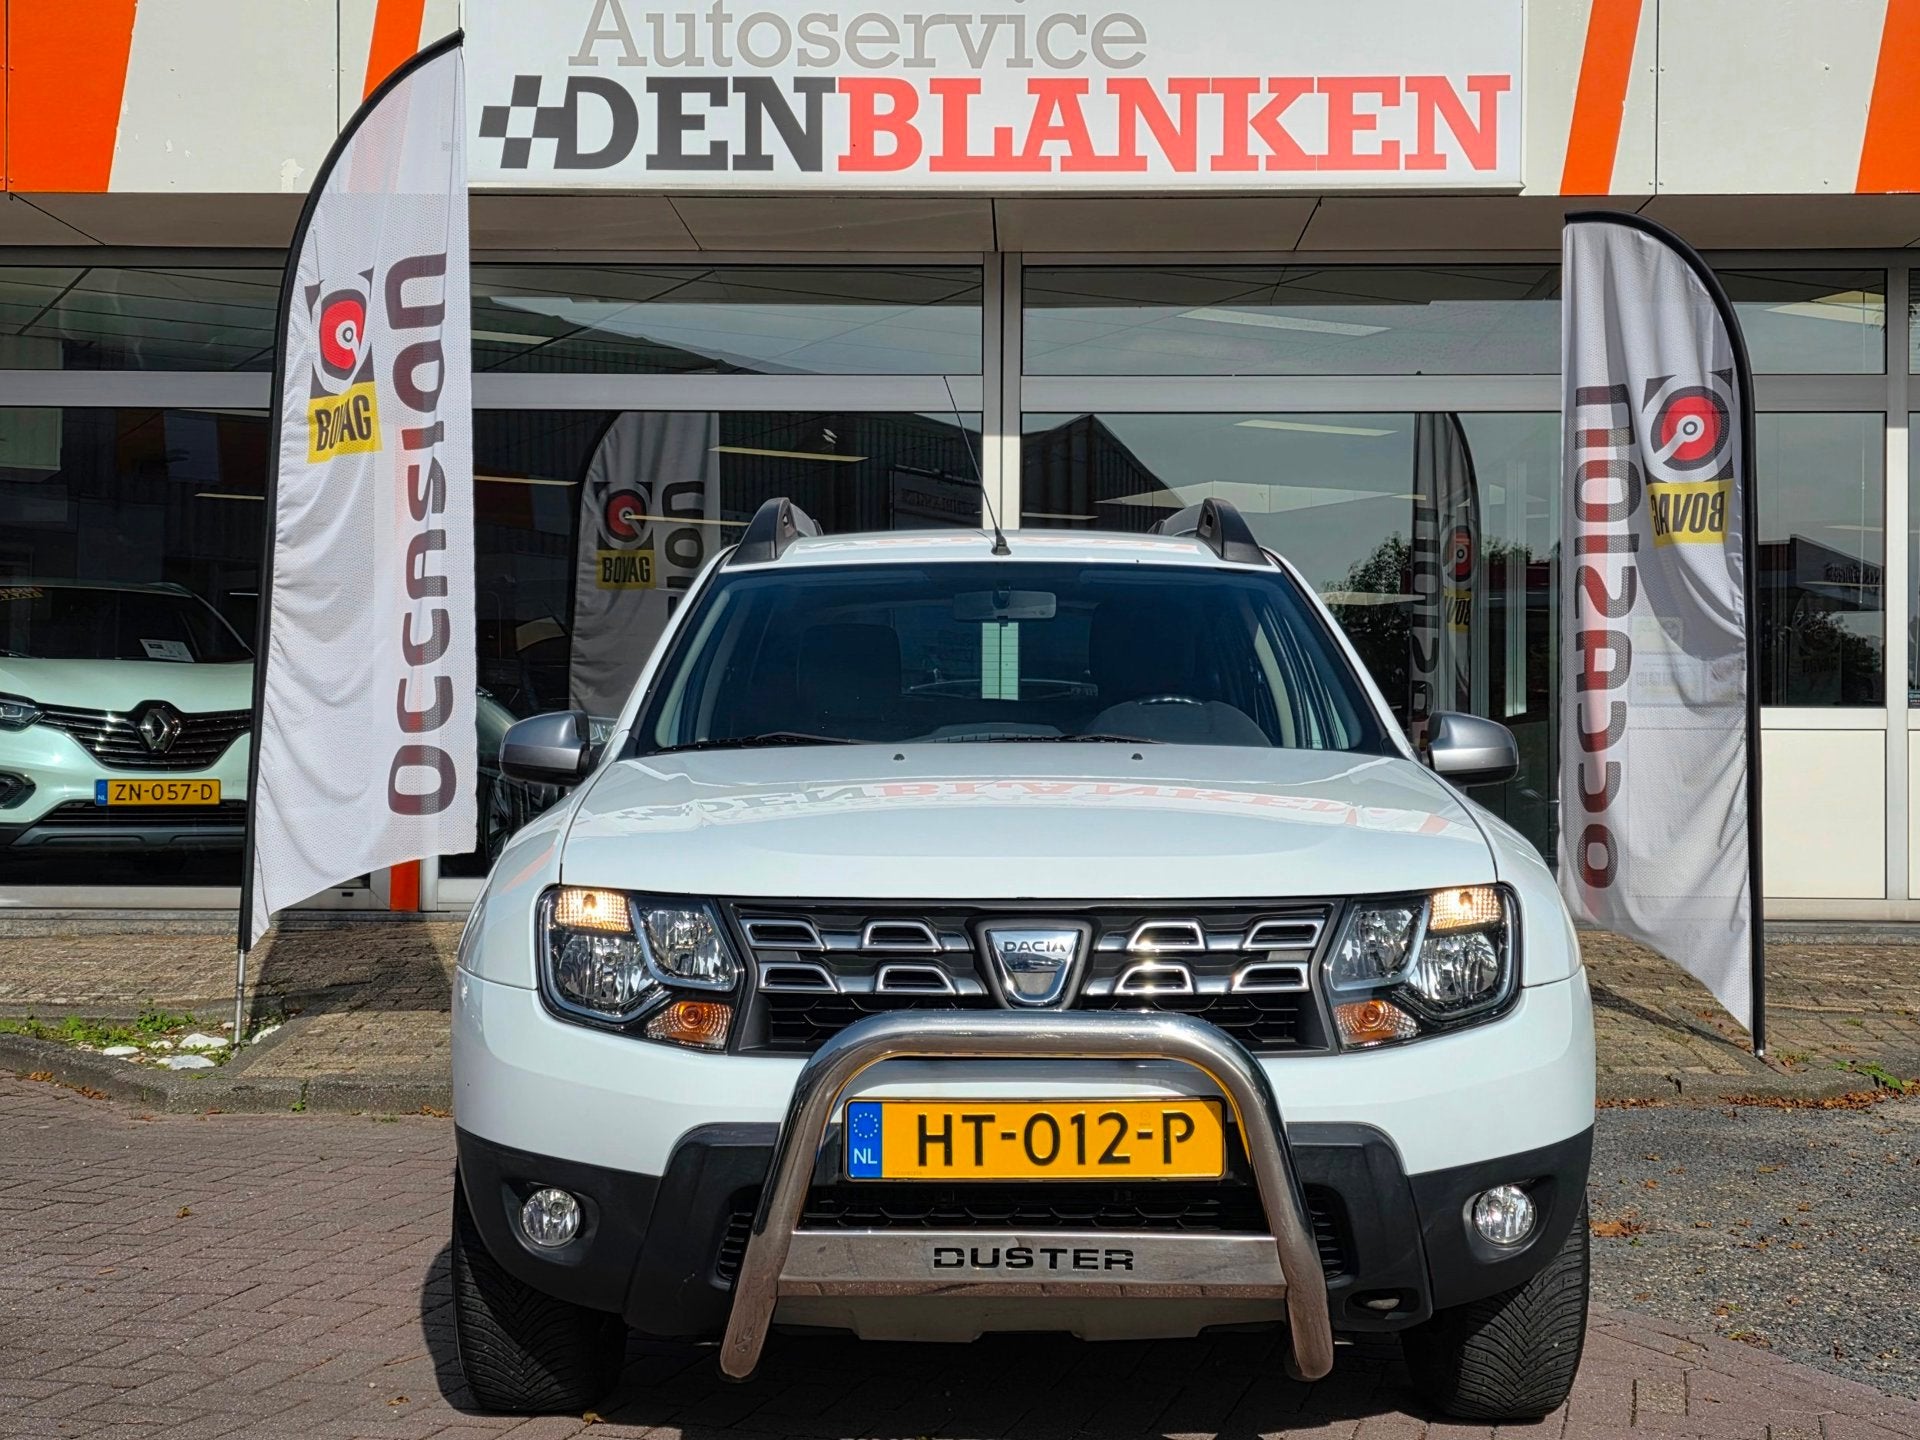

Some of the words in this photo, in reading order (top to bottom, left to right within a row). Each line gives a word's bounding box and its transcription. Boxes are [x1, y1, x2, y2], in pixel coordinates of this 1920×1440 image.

[568, 0, 1148, 69] Autoservice
[601, 556, 650, 584] BOVAG
[114, 783, 213, 801] ZN-057-D
[1003, 941, 1067, 953] DACIA
[917, 1112, 1196, 1167] HT-012-P
[852, 1147, 878, 1165] NL
[933, 1246, 1135, 1272] DUSTER
